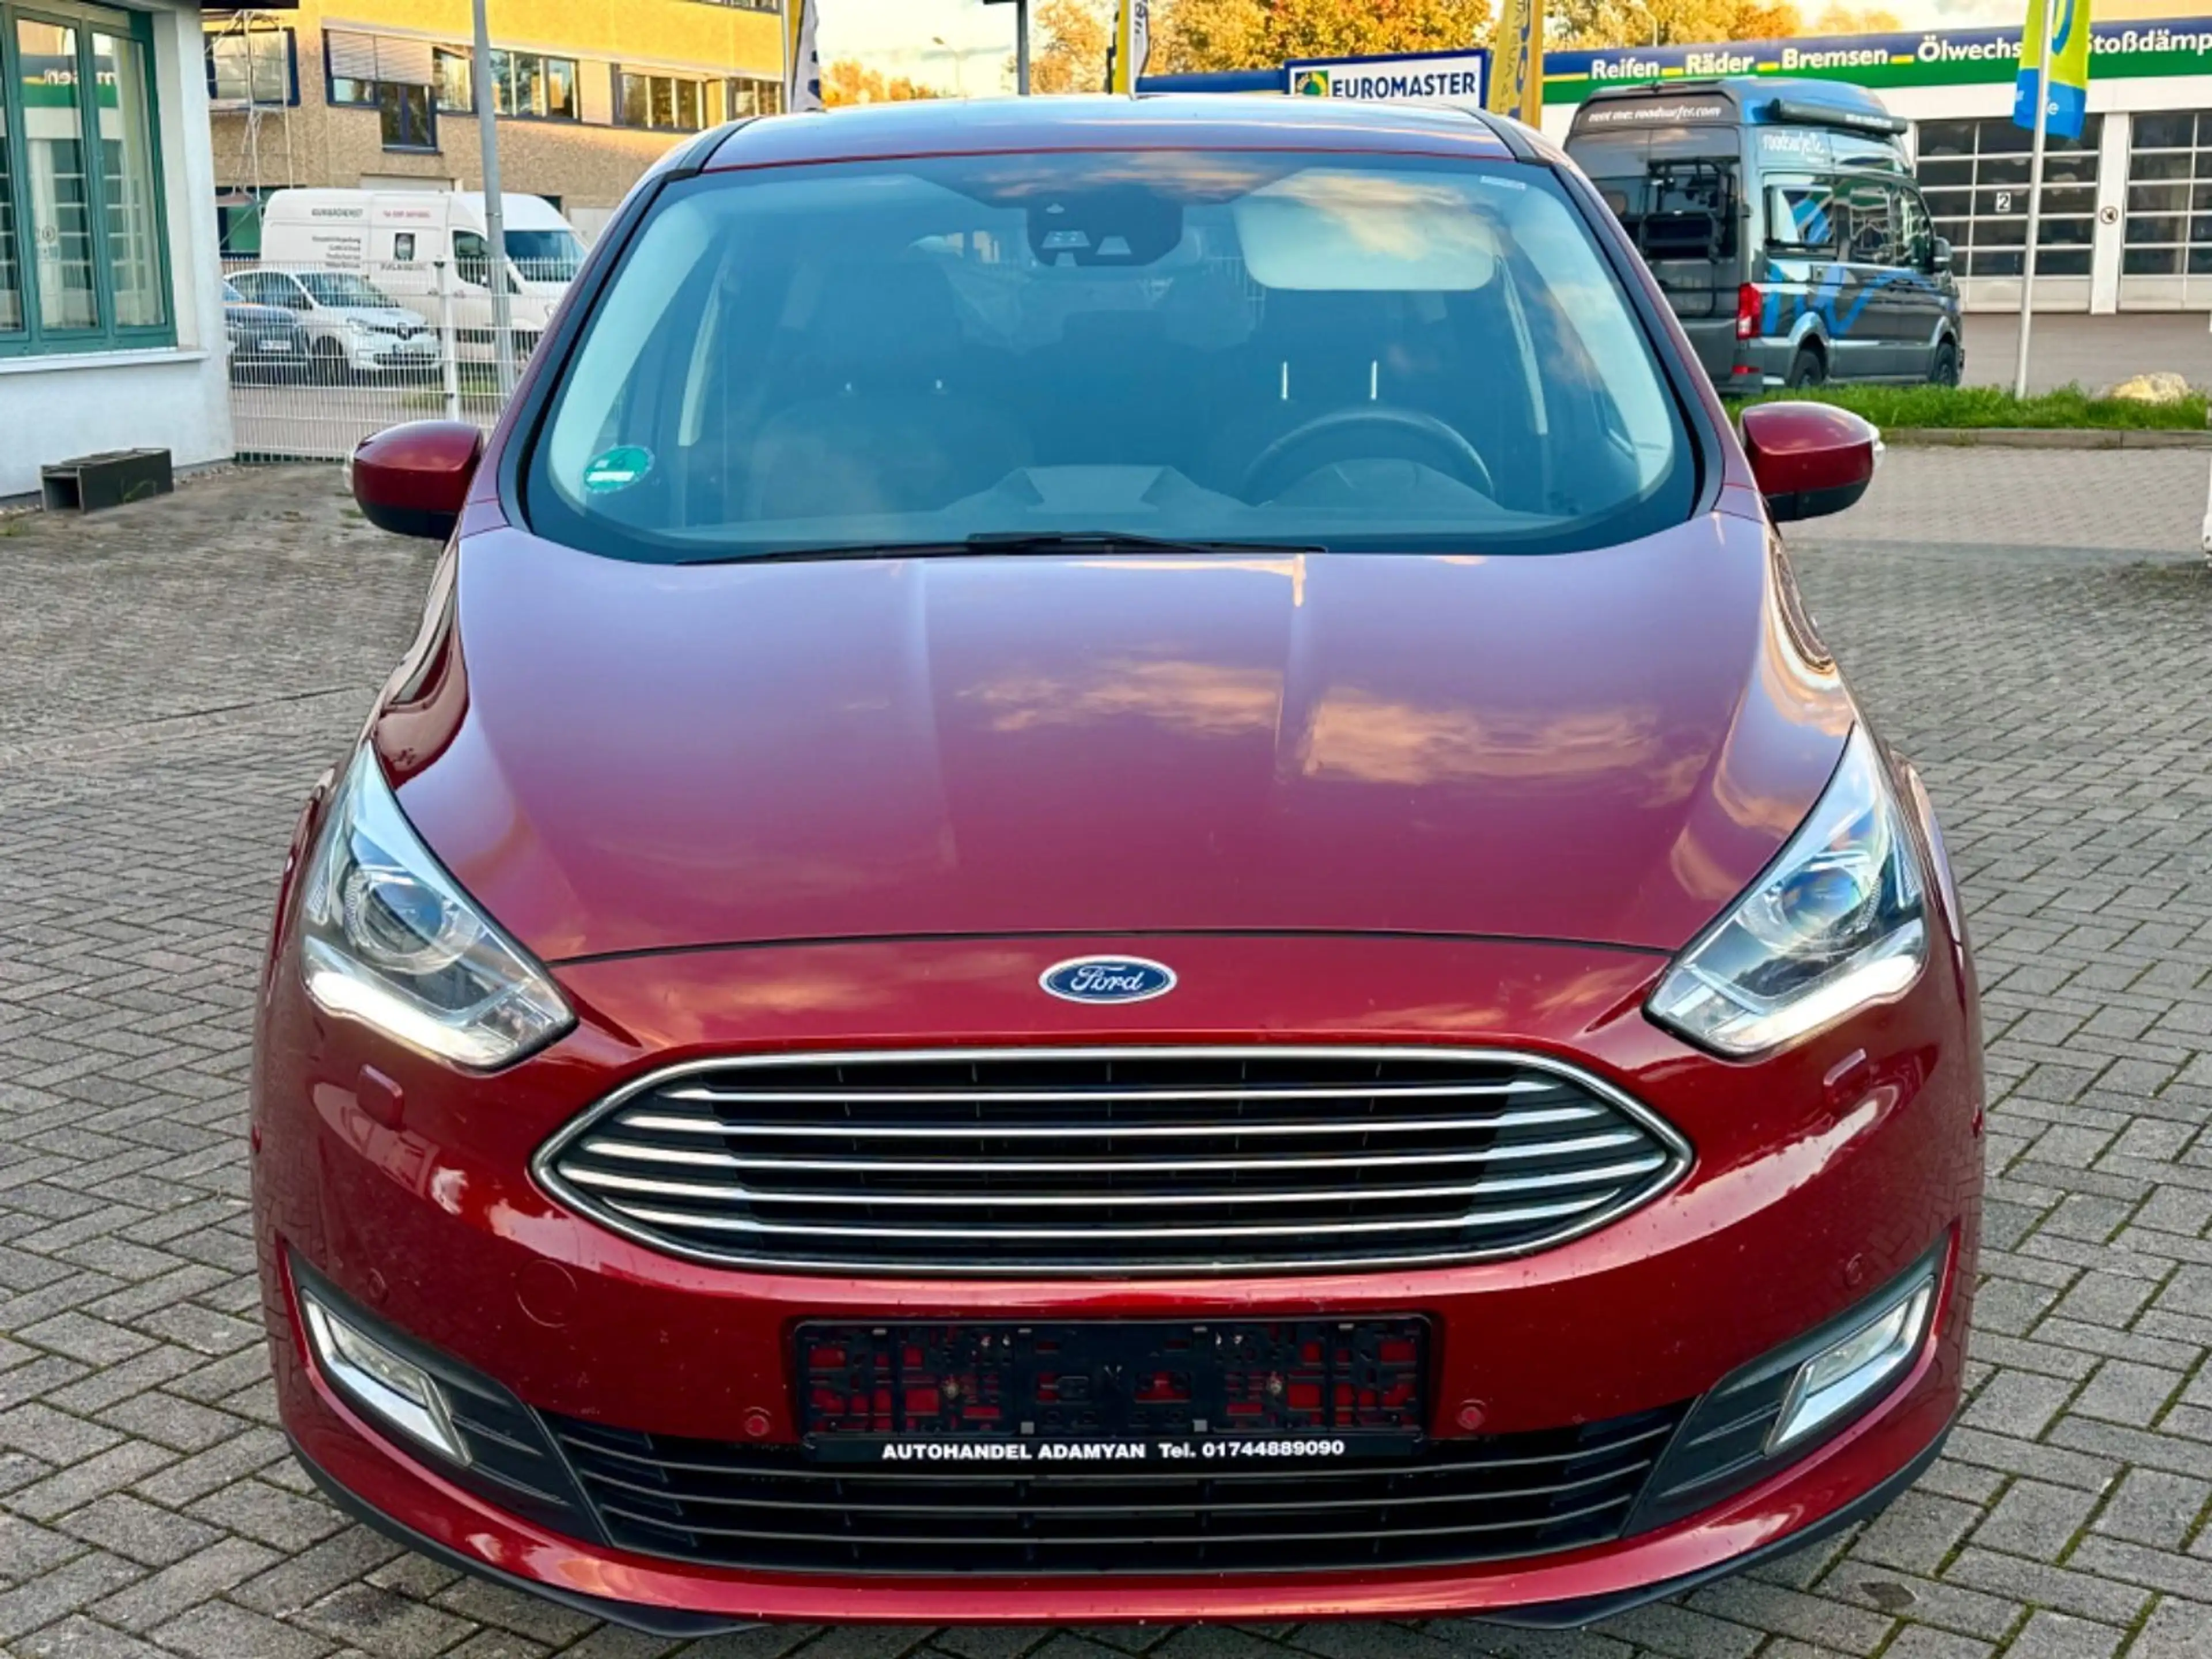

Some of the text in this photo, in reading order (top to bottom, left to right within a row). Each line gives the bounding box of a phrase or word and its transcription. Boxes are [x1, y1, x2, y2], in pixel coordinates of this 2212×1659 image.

[1591, 28, 2212, 79] Reifen Räder Bremsen Ölwechs toßdämp
[1332, 71, 1475, 99] EUROMASTER
[1999, 195, 2009, 210] 2
[1070, 965, 1145, 991] Ford
[882, 1440, 1345, 1460] AUTOHANDEL ADAMYAN Tel. 01744889090
